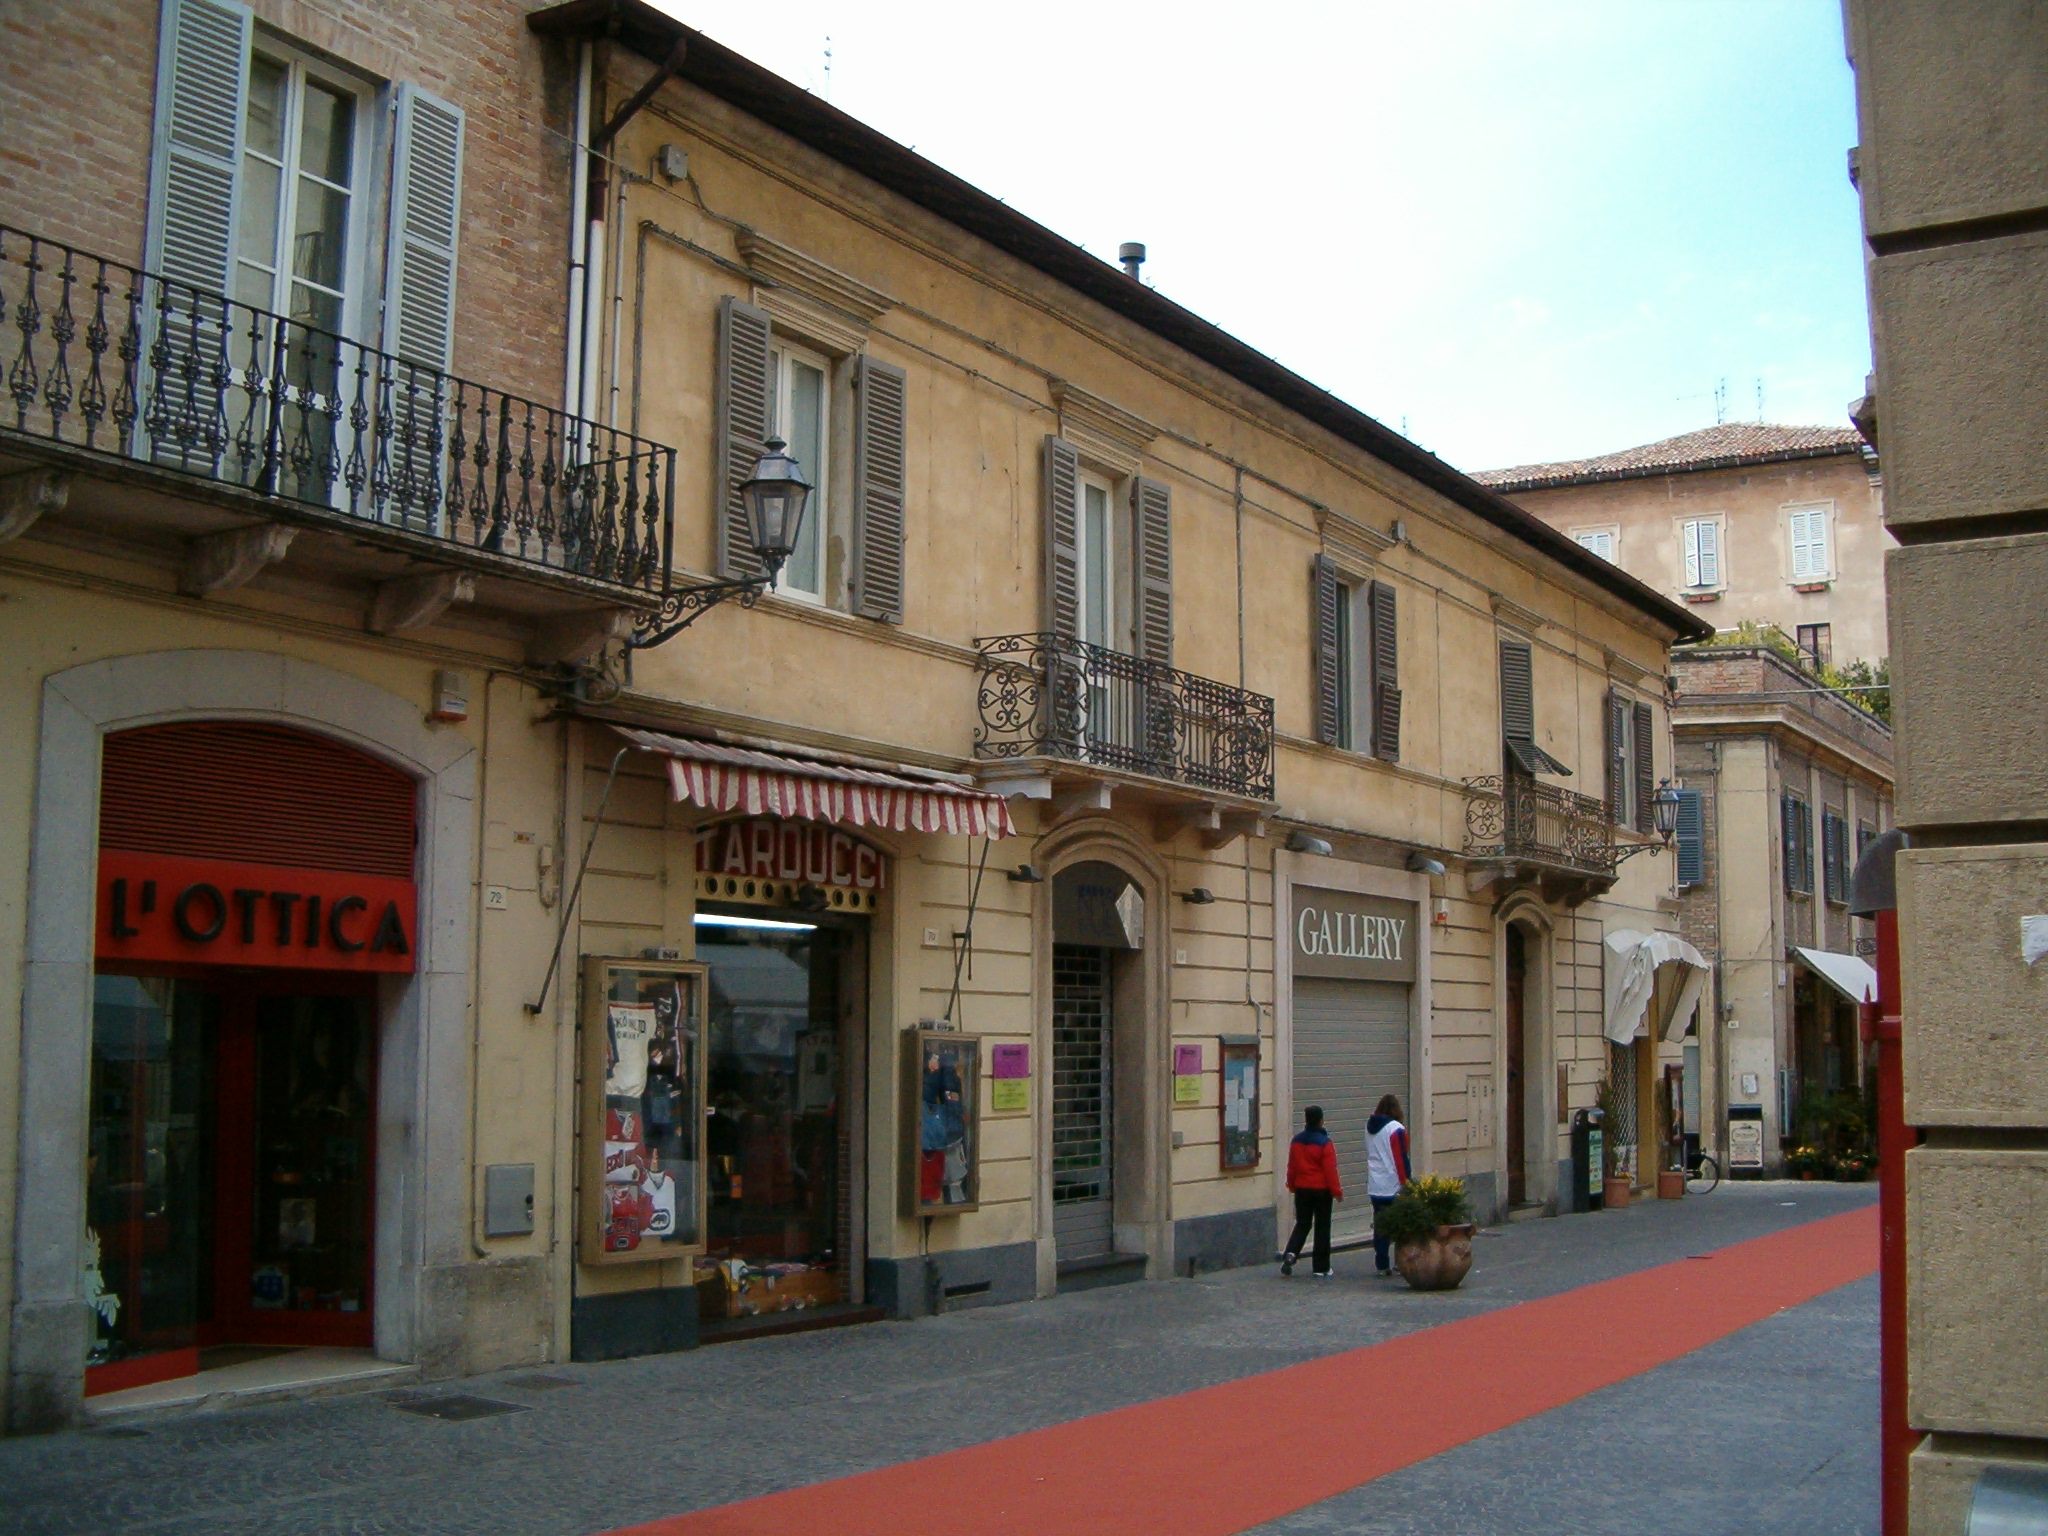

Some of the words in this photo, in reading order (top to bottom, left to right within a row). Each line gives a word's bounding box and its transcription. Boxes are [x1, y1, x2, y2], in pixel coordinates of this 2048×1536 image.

[696, 821, 885, 888] TARDUCCI
[490, 891, 502, 904] 72
[1298, 907, 1406, 961] GALLERY
